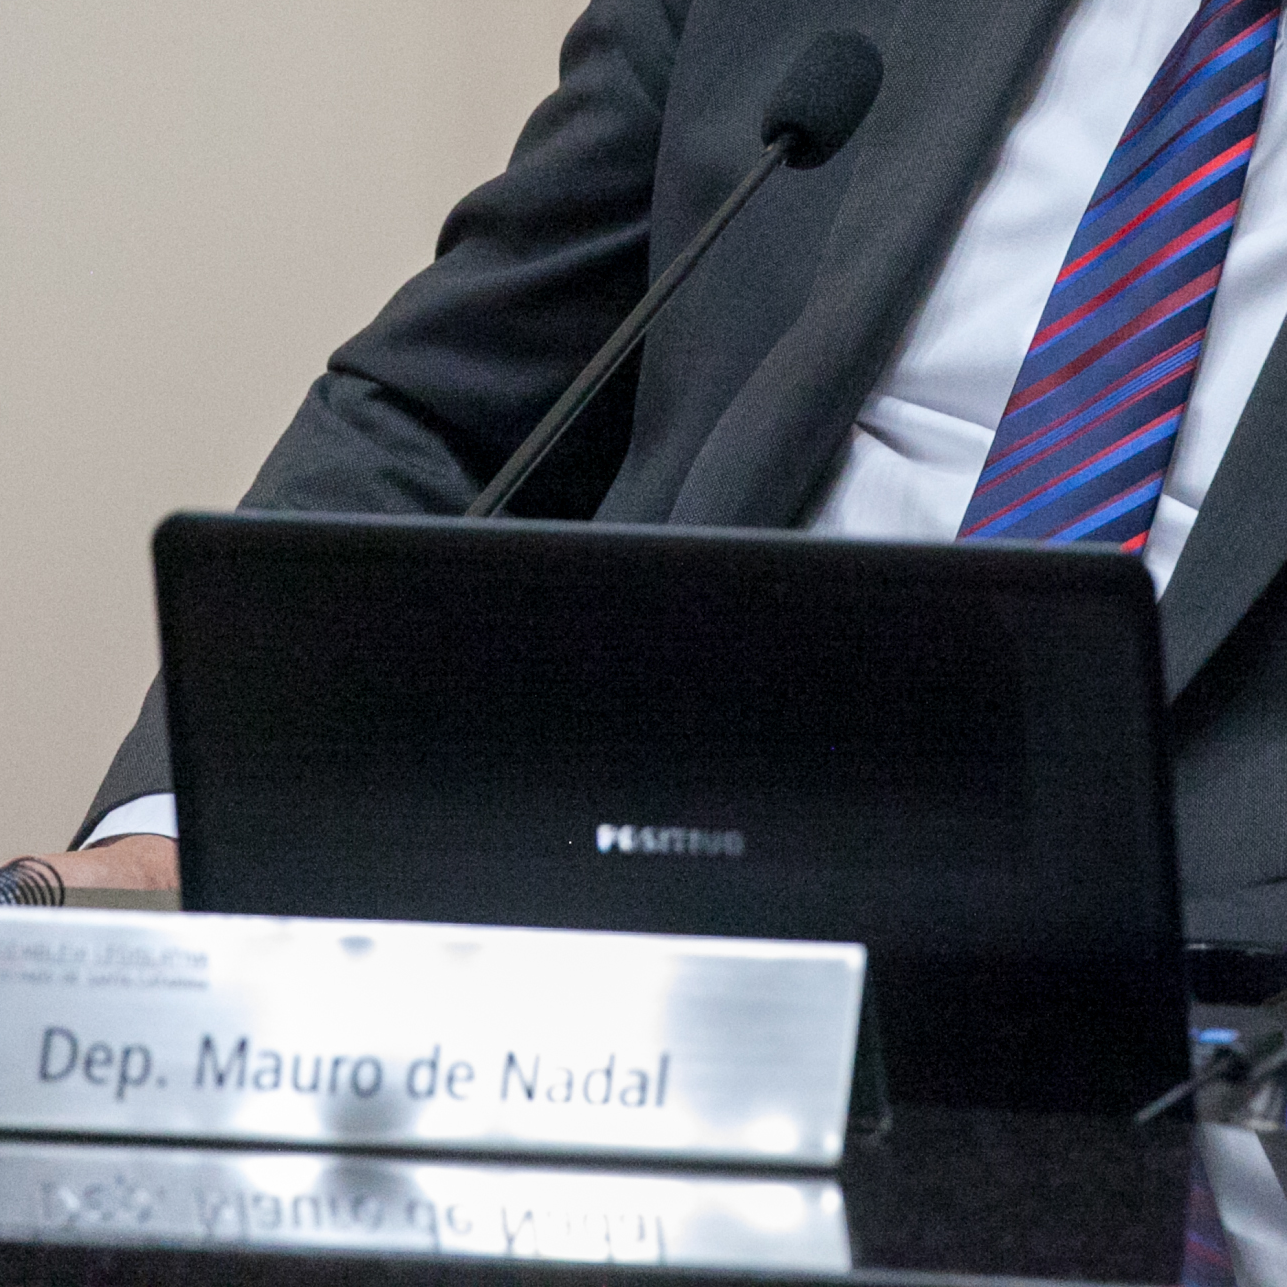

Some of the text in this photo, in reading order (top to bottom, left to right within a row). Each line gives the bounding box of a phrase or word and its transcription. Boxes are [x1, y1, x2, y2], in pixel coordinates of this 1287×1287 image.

[38, 1025, 672, 1108] Dep. Mauro de Nadal
